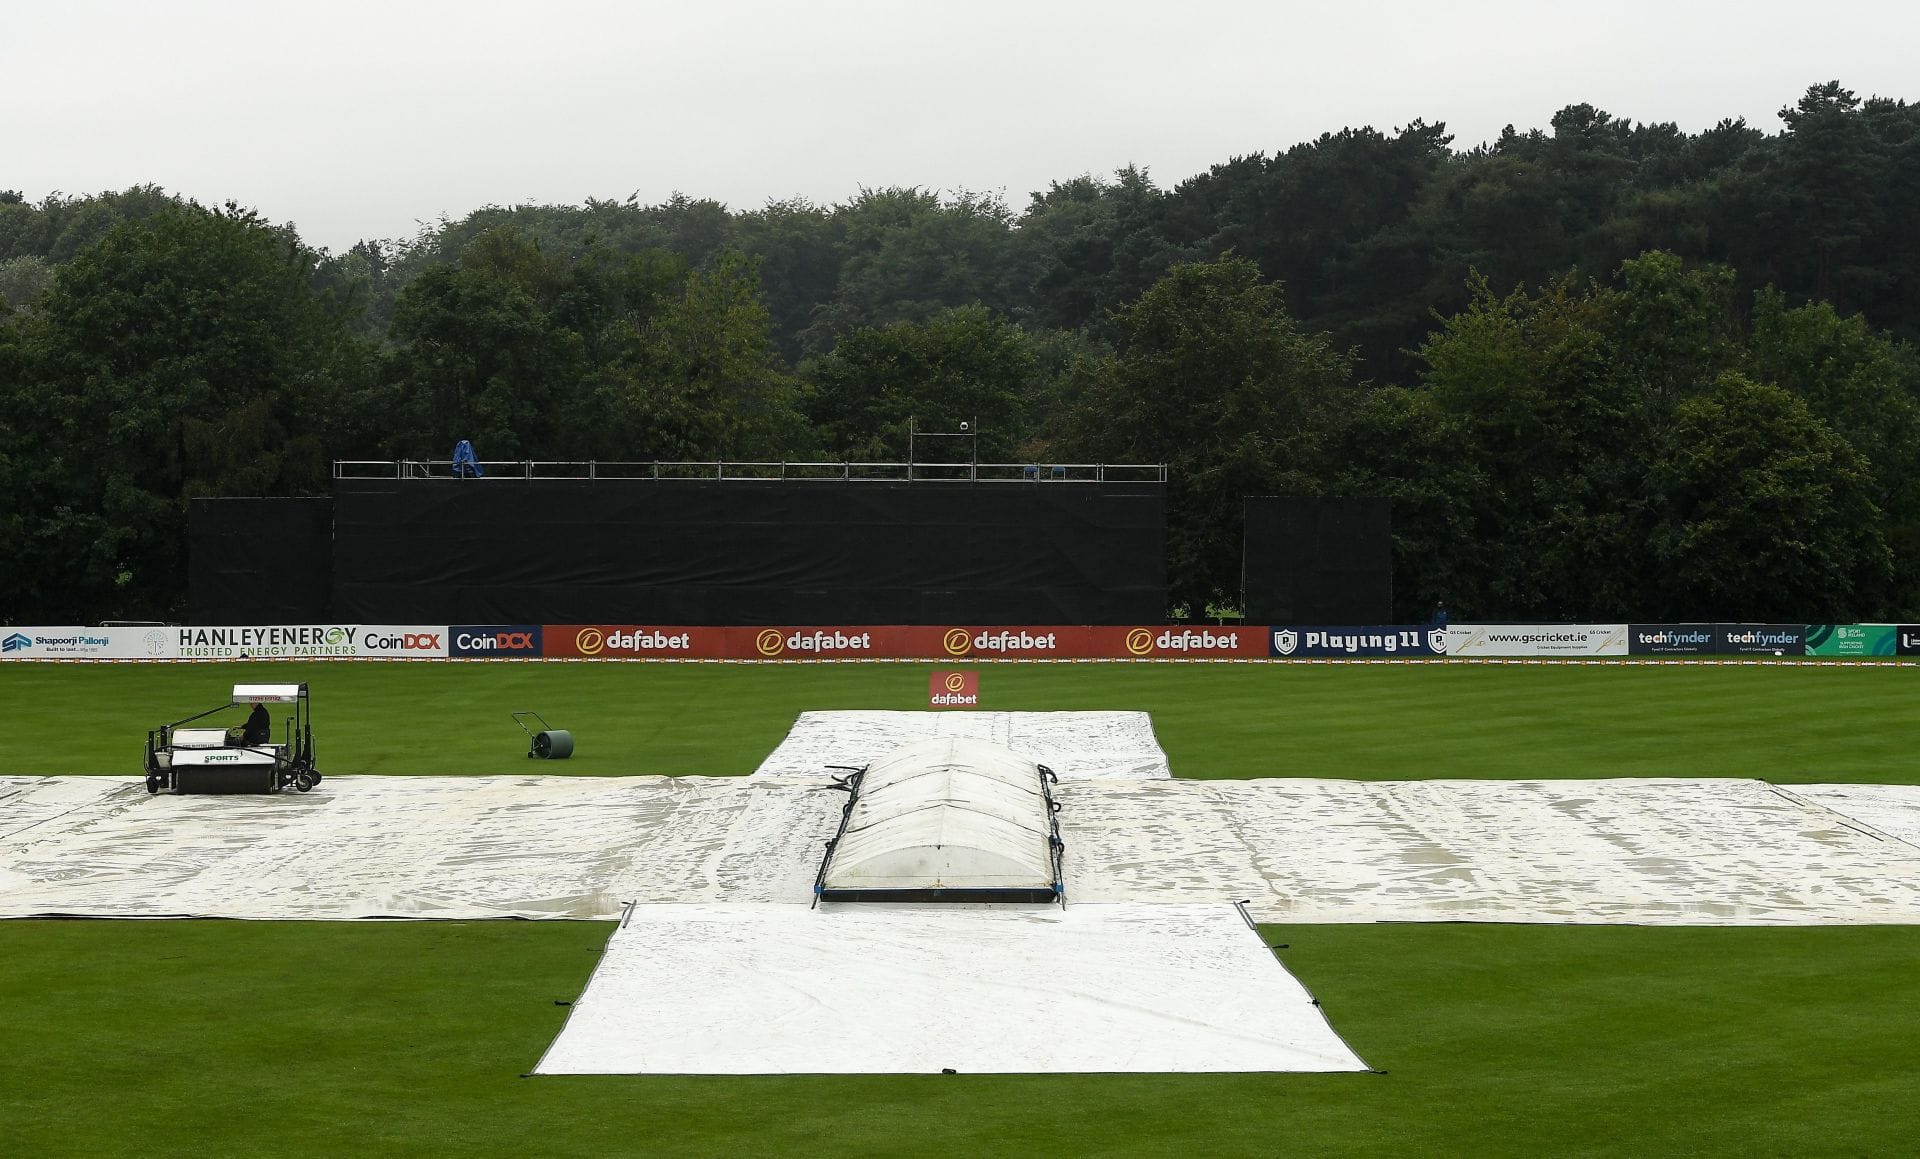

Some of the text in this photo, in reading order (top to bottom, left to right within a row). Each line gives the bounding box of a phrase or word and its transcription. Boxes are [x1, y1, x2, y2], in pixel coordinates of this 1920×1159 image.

[35, 636, 109, 646] Shapoorji Pallonji
[179, 627, 357, 646] HANLEYENERGY
[364, 633, 441, 650] CoinDCX
[456, 632, 533, 650] CoinDCX
[606, 630, 690, 651] dafabet
[786, 631, 870, 652] dafabet
[973, 630, 1056, 652] dafabet
[1156, 630, 1238, 651] dafabet
[1305, 631, 1420, 652] Playing11
[1488, 632, 1588, 643] www.gscricket.ie
[1638, 631, 1711, 646] techfynder
[1726, 631, 1799, 646] techfynder
[180, 645, 356, 657] TRUSTED ENERGY PARTNERS
[931, 693, 977, 705] dafabet
